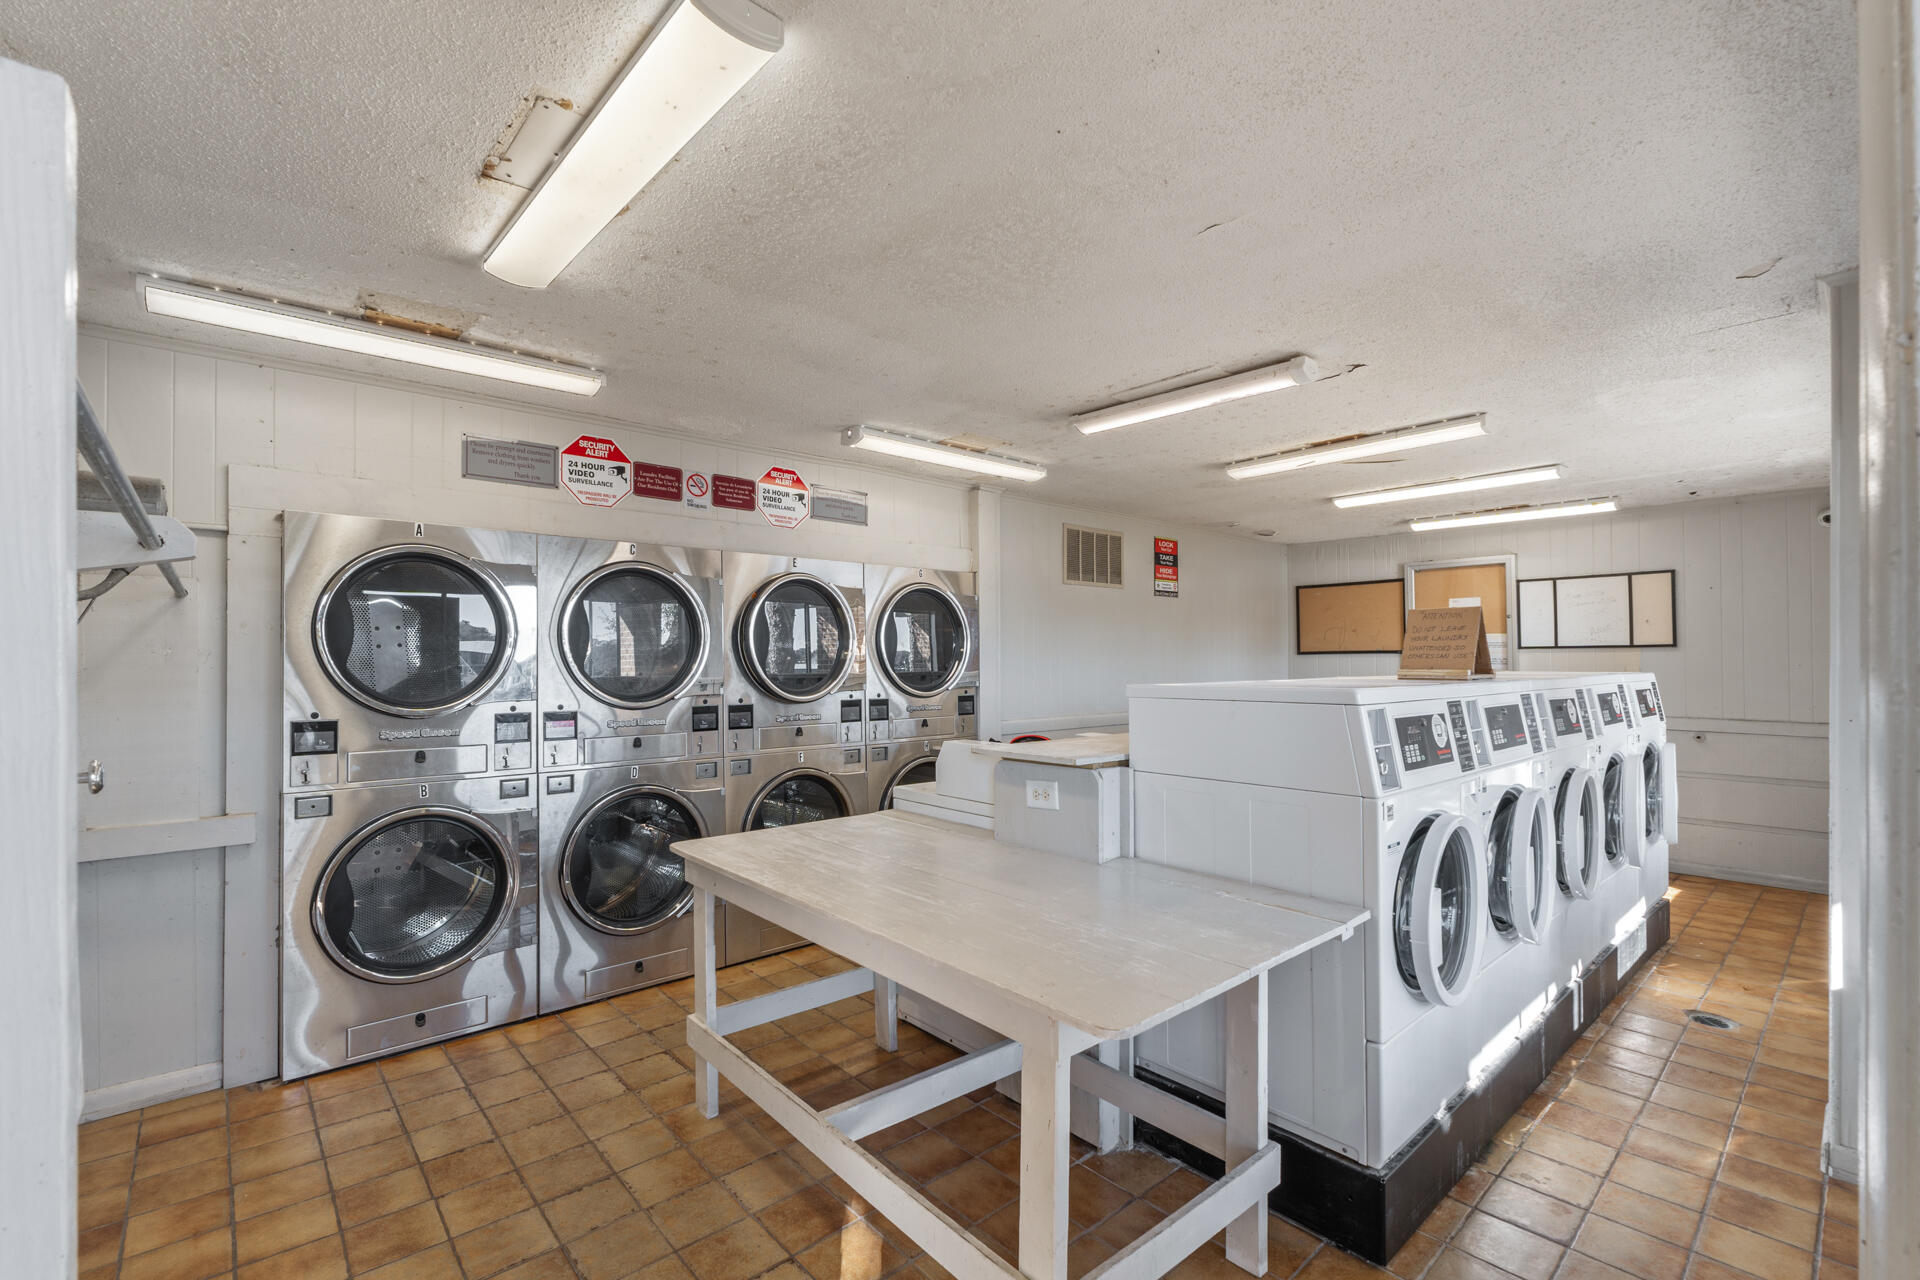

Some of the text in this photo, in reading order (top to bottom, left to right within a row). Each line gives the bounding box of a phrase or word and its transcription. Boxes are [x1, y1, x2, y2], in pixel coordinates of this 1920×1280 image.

[579, 439, 615, 452] SECURITY
[495, 451, 515, 461] clothing
[585, 448, 609, 458] ALERT
[499, 459, 515, 468] dryers
[568, 460, 605, 471] 24 HOUR
[568, 468, 595, 478] VIDEO
[770, 470, 797, 481] SECURITY
[568, 477, 613, 488] SURVEILLANCE
[775, 478, 792, 486] ALERT
[771, 489, 790, 498] HOUR
[762, 495, 782, 504] VIDEO
[762, 502, 796, 512] SURVEILLANCE
[415, 524, 423, 537] A
[630, 544, 636, 555] C
[792, 557, 797, 568] E
[1440, 624, 1467, 632] LEAVE
[1431, 633, 1469, 641] LAUNDRY
[607, 718, 637, 730] Speed
[379, 728, 460, 742] Speed Queen
[632, 767, 638, 778] D
[421, 784, 428, 797] B
